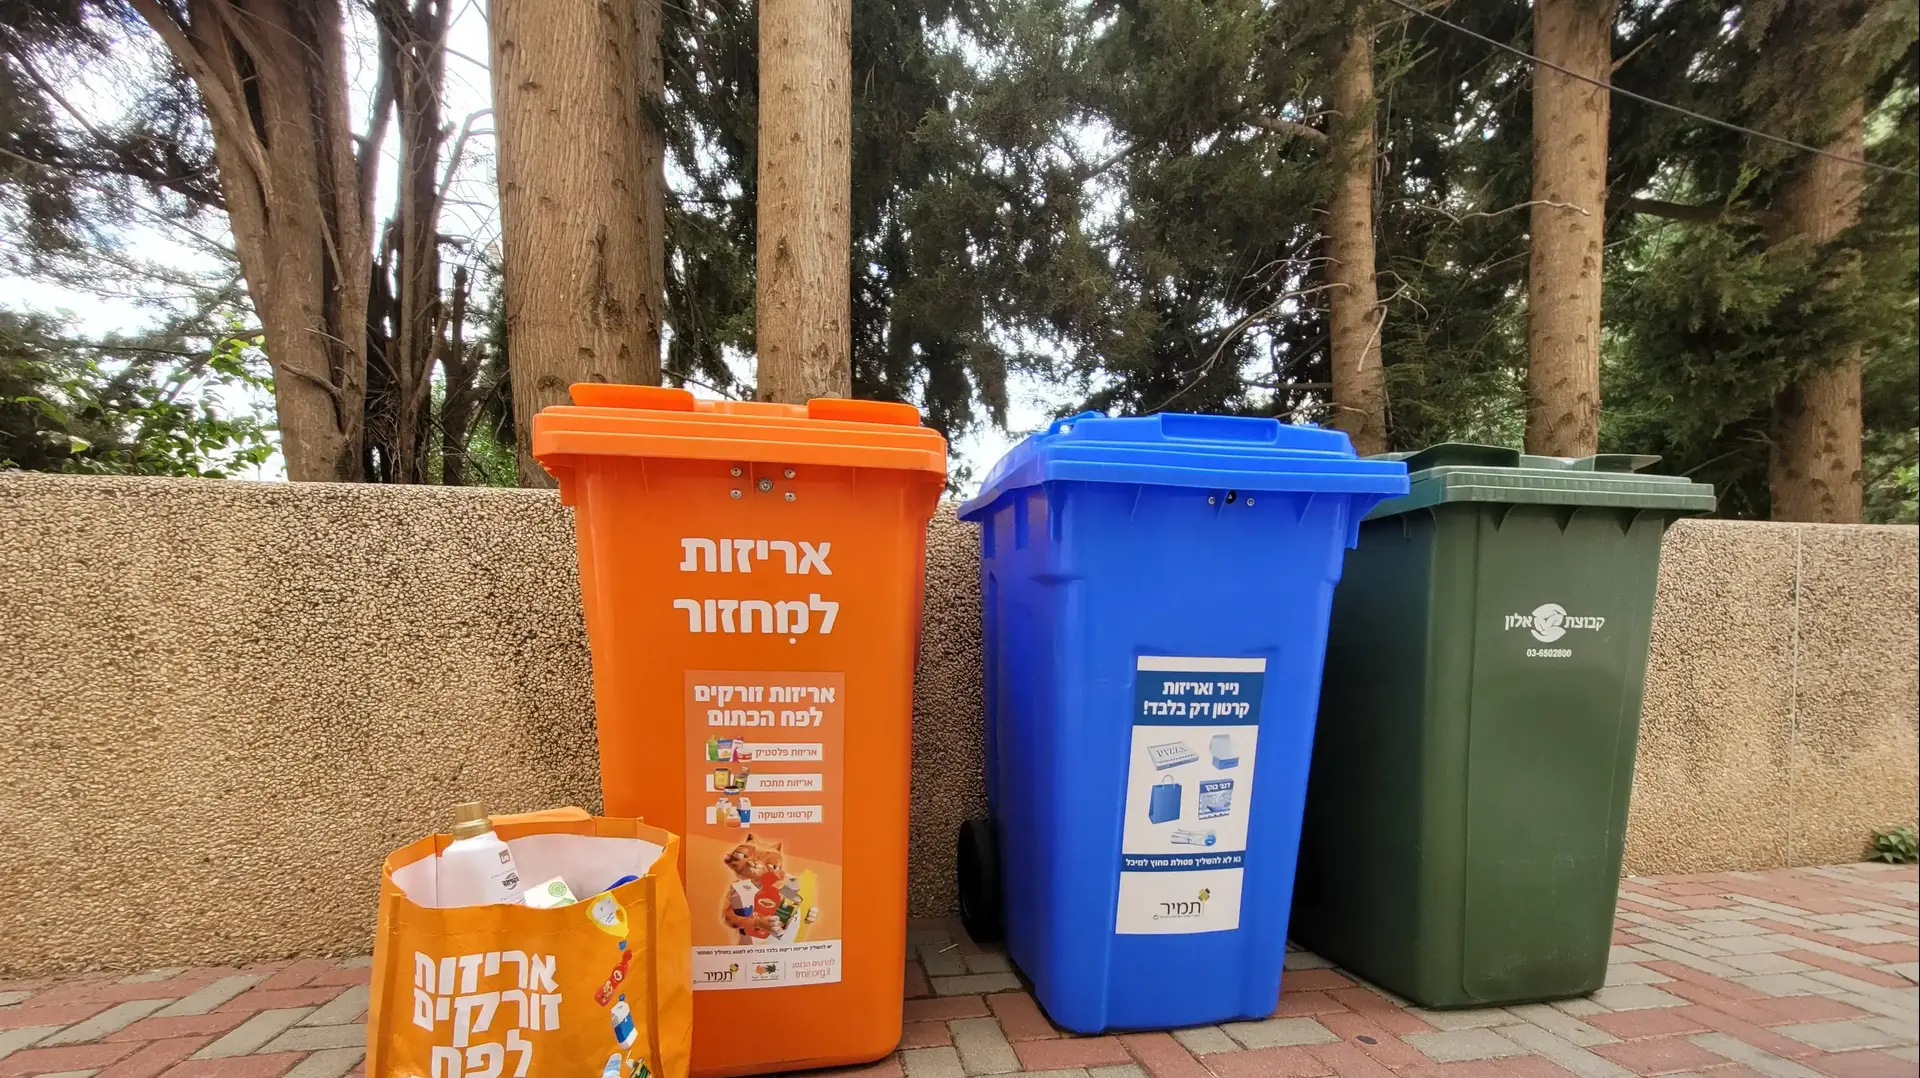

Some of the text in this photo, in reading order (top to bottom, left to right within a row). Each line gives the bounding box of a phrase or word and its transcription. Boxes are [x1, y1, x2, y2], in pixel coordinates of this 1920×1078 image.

[680, 537, 833, 576] אריזות
[1504, 612, 1606, 632] קבוצת אלון
[1526, 648, 1573, 658] 03-6502800
[1162, 681, 1240, 696] נייר ואריזות
[693, 685, 836, 708] אריזות זורקים
[1143, 699, 1250, 719] קרטון דק בלבד!
[707, 706, 824, 727] לפח הכתום
[755, 747, 818, 759] אריזות פלסטיק
[759, 779, 814, 788] אריזות מתכת
[758, 811, 814, 822] קרטוני משקה
[1125, 858, 1149, 867] למיכל
[1150, 859, 1169, 868] מחוץ
[1170, 858, 1194, 867] פסולת
[1194, 856, 1222, 867] להשליך
[1222, 855, 1233, 864] לא
[1160, 901, 1202, 915] תמיר
[414, 950, 559, 995] אריזות
[703, 970, 733, 981] תמיר
[413, 988, 562, 1048] זורקים
[431, 1029, 533, 1078] לפח
